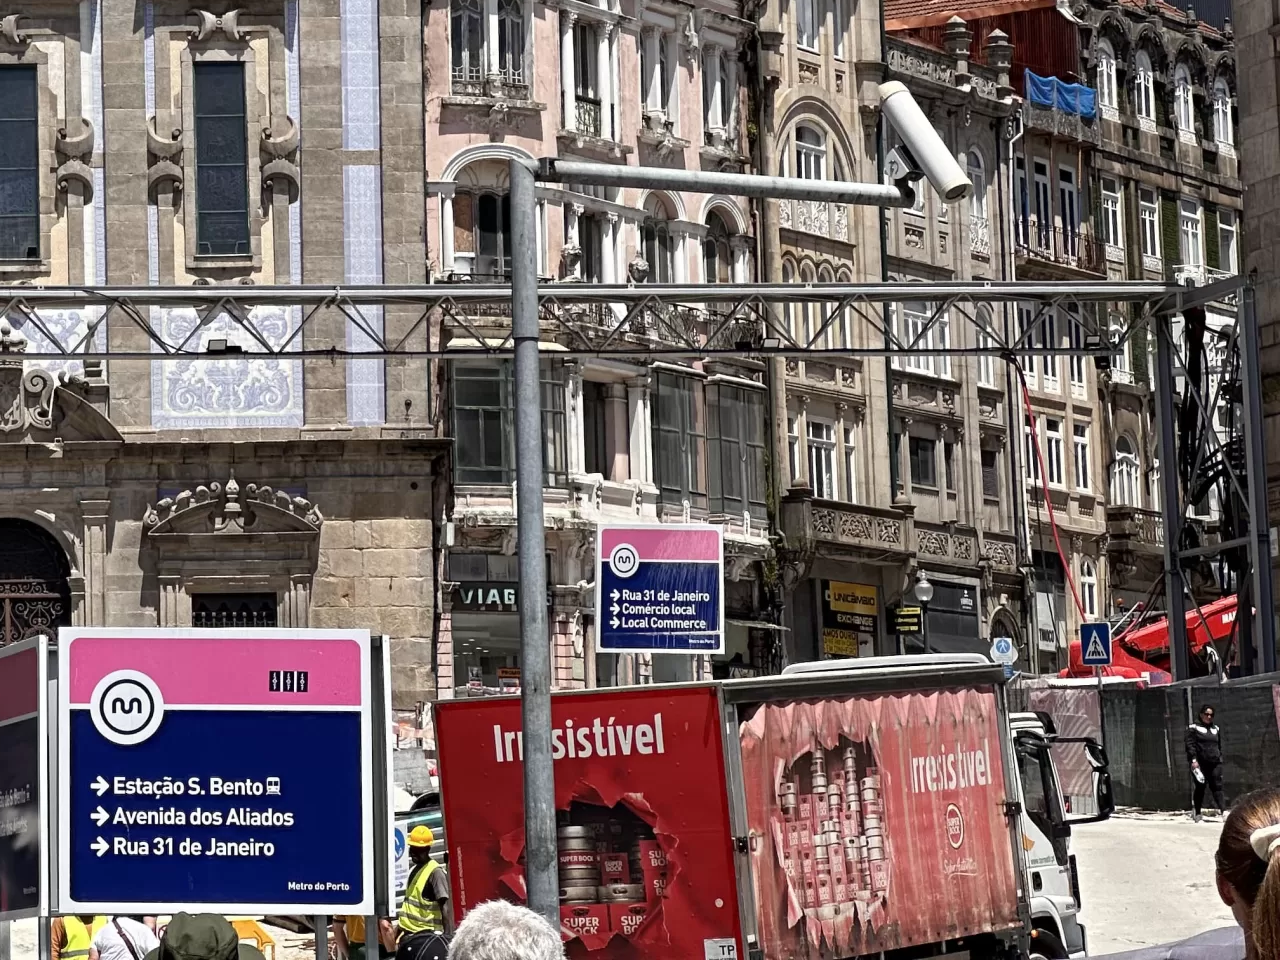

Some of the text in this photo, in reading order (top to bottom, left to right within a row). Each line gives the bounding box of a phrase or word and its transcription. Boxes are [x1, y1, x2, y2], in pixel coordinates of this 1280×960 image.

[622, 590, 710, 602] Rua 31 de Janeiro
[622, 603, 696, 615] Comércio local
[622, 617, 706, 628] Local Commerce
[494, 712, 665, 762] Irrsistível
[114, 776, 263, 799] Estação S. Bento
[113, 807, 294, 826] Avenida dos Aliados
[114, 837, 275, 856] Rua 31 de Janeiro
[288, 882, 349, 891] Metro do Porto
[564, 917, 599, 927] SUPER
[719, 945, 734, 955] TP
